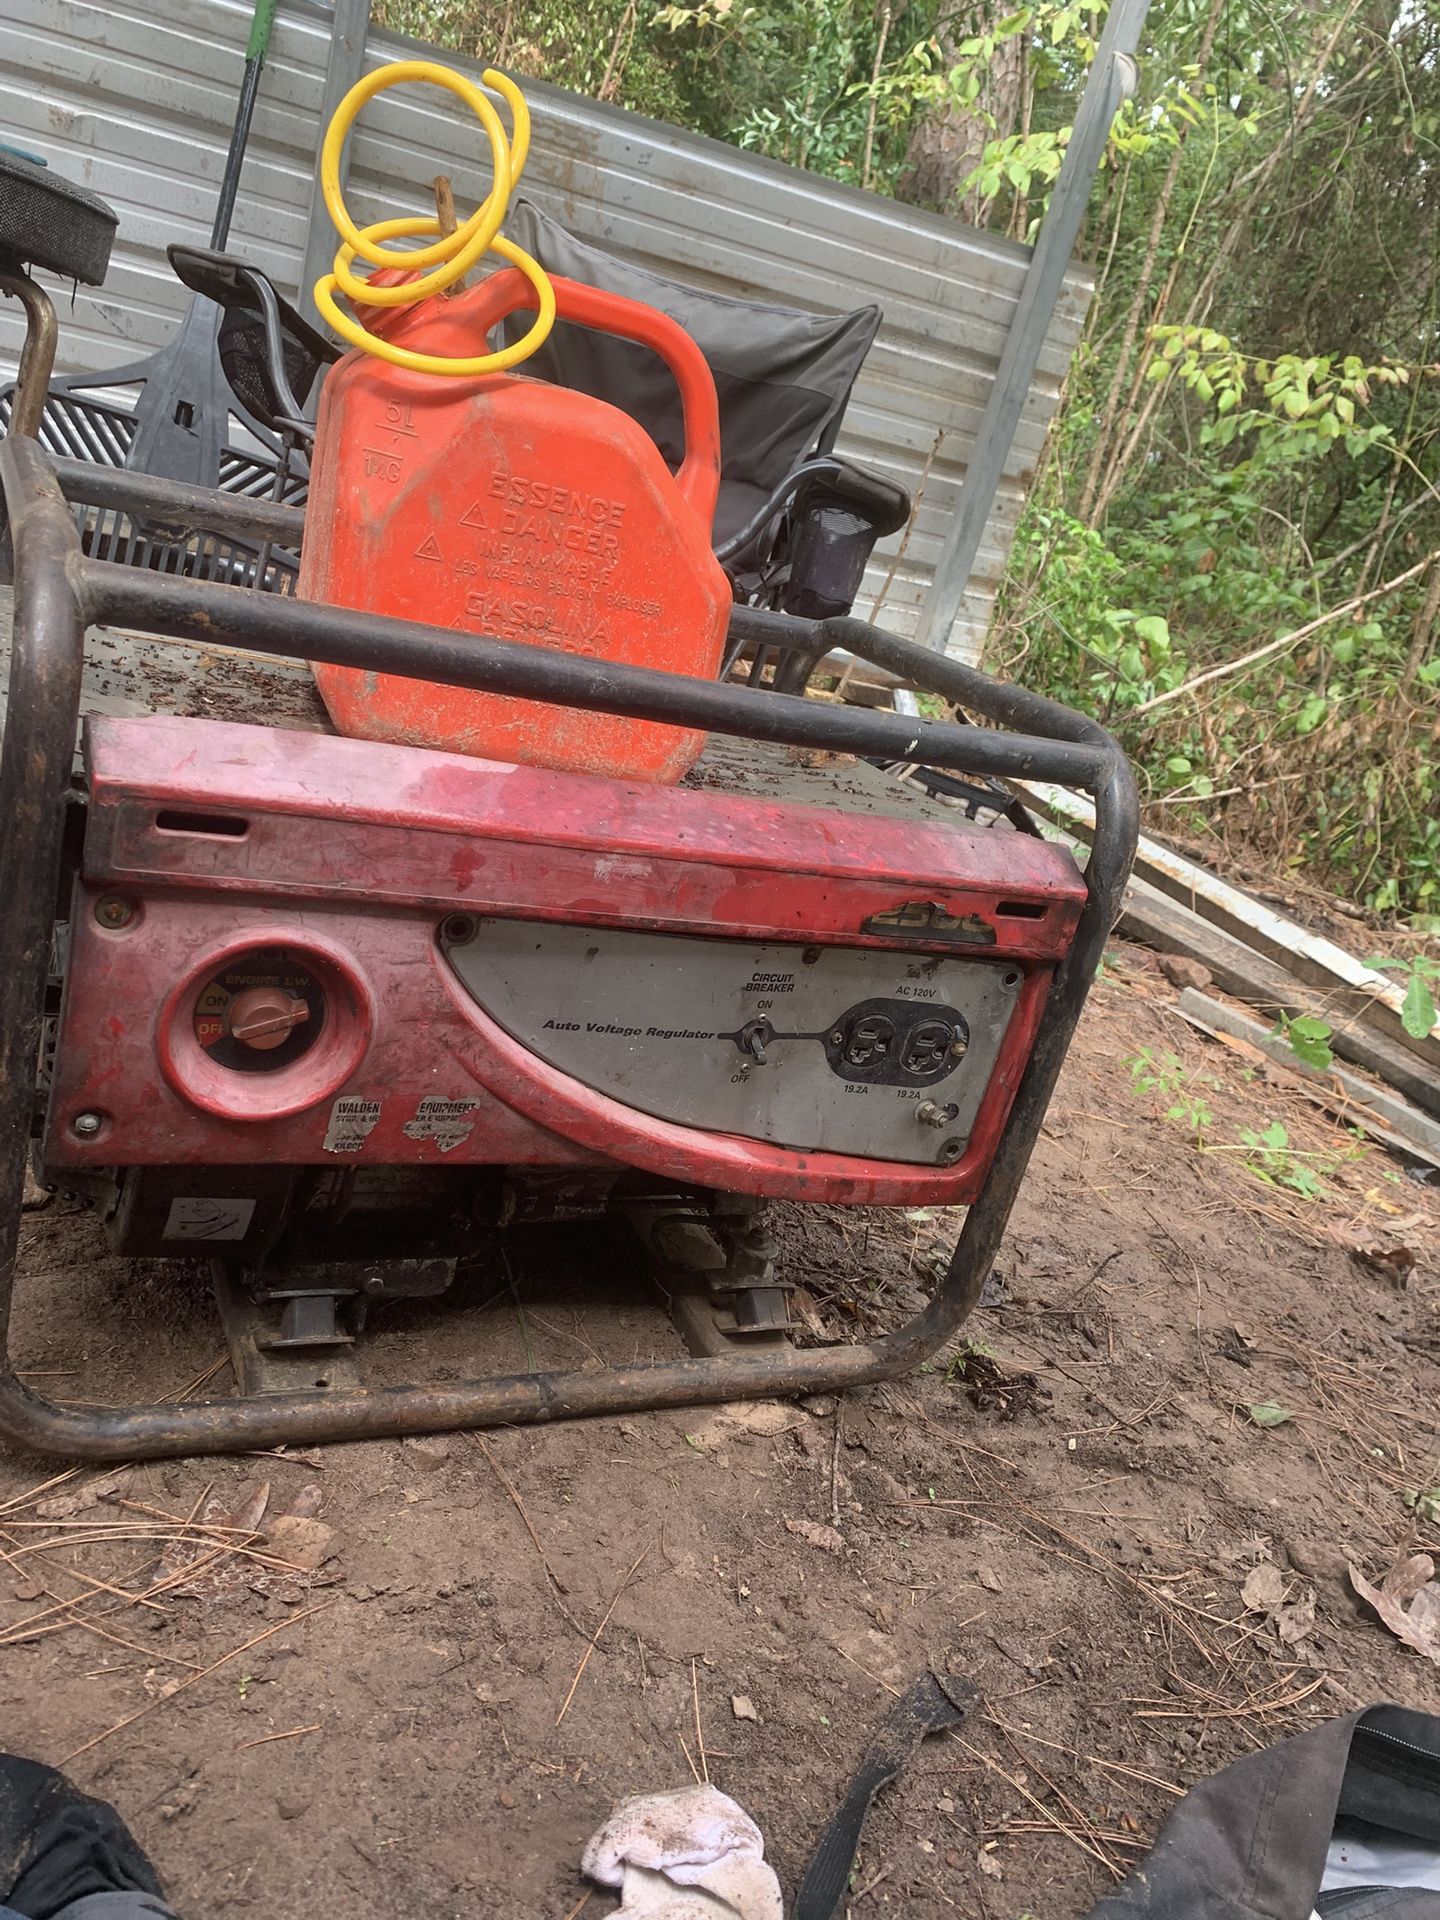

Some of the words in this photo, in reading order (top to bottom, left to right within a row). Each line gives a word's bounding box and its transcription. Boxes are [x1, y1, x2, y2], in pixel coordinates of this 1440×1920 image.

[385, 400, 415, 429] 5L
[487, 470, 626, 529] ESSENCE
[500, 508, 619, 562] DANGER
[479, 540, 614, 586] INFLAMMABLE
[464, 591, 611, 646] GASOLINA
[751, 972, 795, 983] CIRCUIT
[745, 982, 796, 993] BREAKER
[895, 985, 911, 996] AC
[913, 986, 937, 998] 120V
[206, 995, 229, 1008] ON
[757, 1000, 773, 1010] ON
[542, 1019, 581, 1032] Auto
[586, 1022, 642, 1037] Voltage
[645, 1027, 716, 1040] Regulator
[730, 1074, 751, 1084] OFF
[843, 1084, 869, 1095] 19.2A
[896, 1089, 921, 1100] 19.2A
[338, 1102, 381, 1114] WALDEN
[419, 1102, 477, 1114] EQUIPMENT
